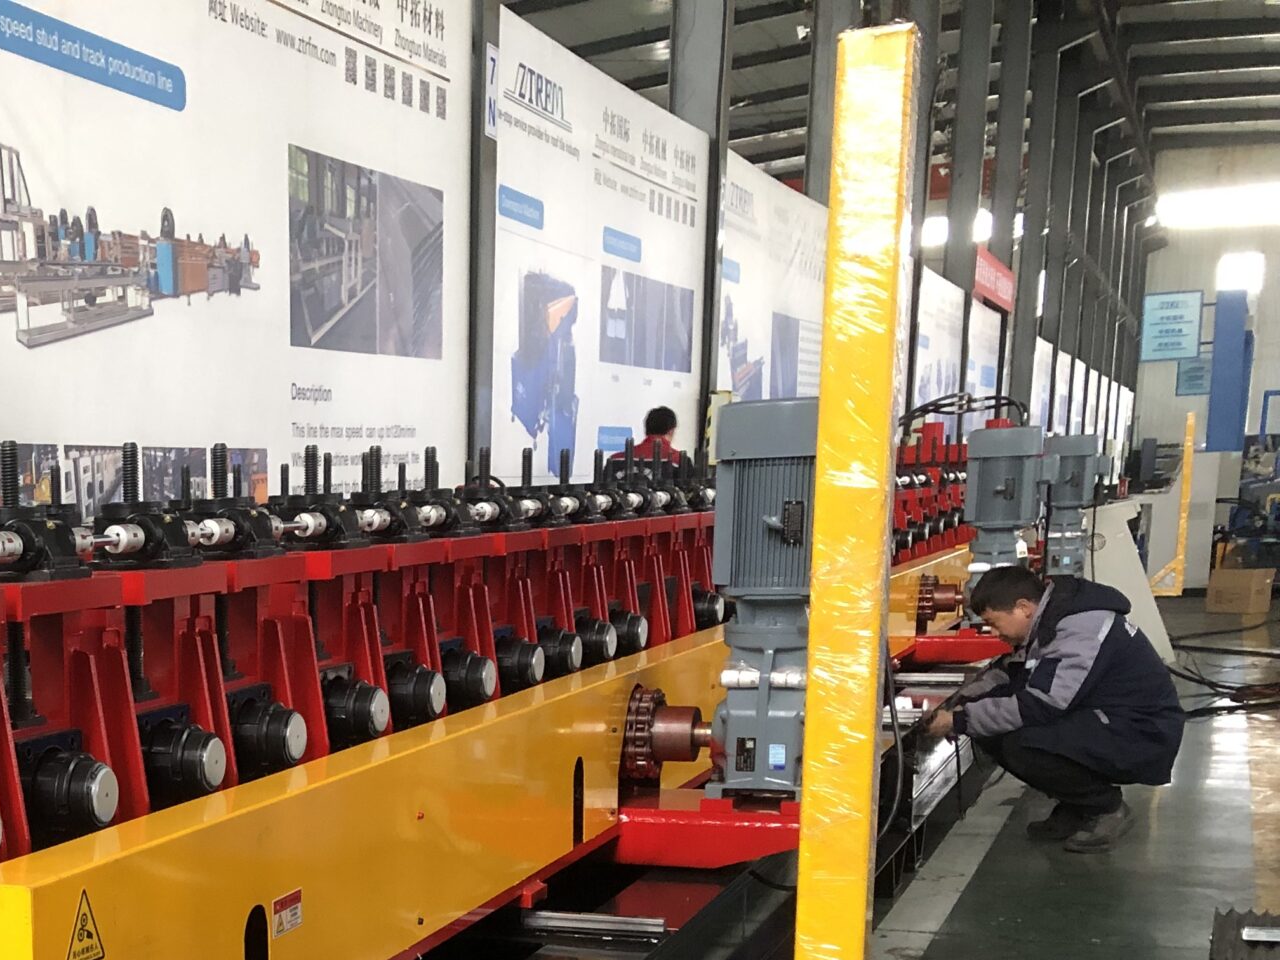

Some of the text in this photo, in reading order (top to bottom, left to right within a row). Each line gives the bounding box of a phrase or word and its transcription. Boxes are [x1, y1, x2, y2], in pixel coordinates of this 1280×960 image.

[0, 15, 33, 42] speed
[35, 27, 59, 51] stud
[61, 39, 80, 59] and
[81, 45, 105, 68] track
[108, 55, 155, 87] production
[157, 70, 173, 93] line
[490, 57, 496, 85] 7
[488, 96, 496, 127] N
[291, 382, 332, 405] Description
